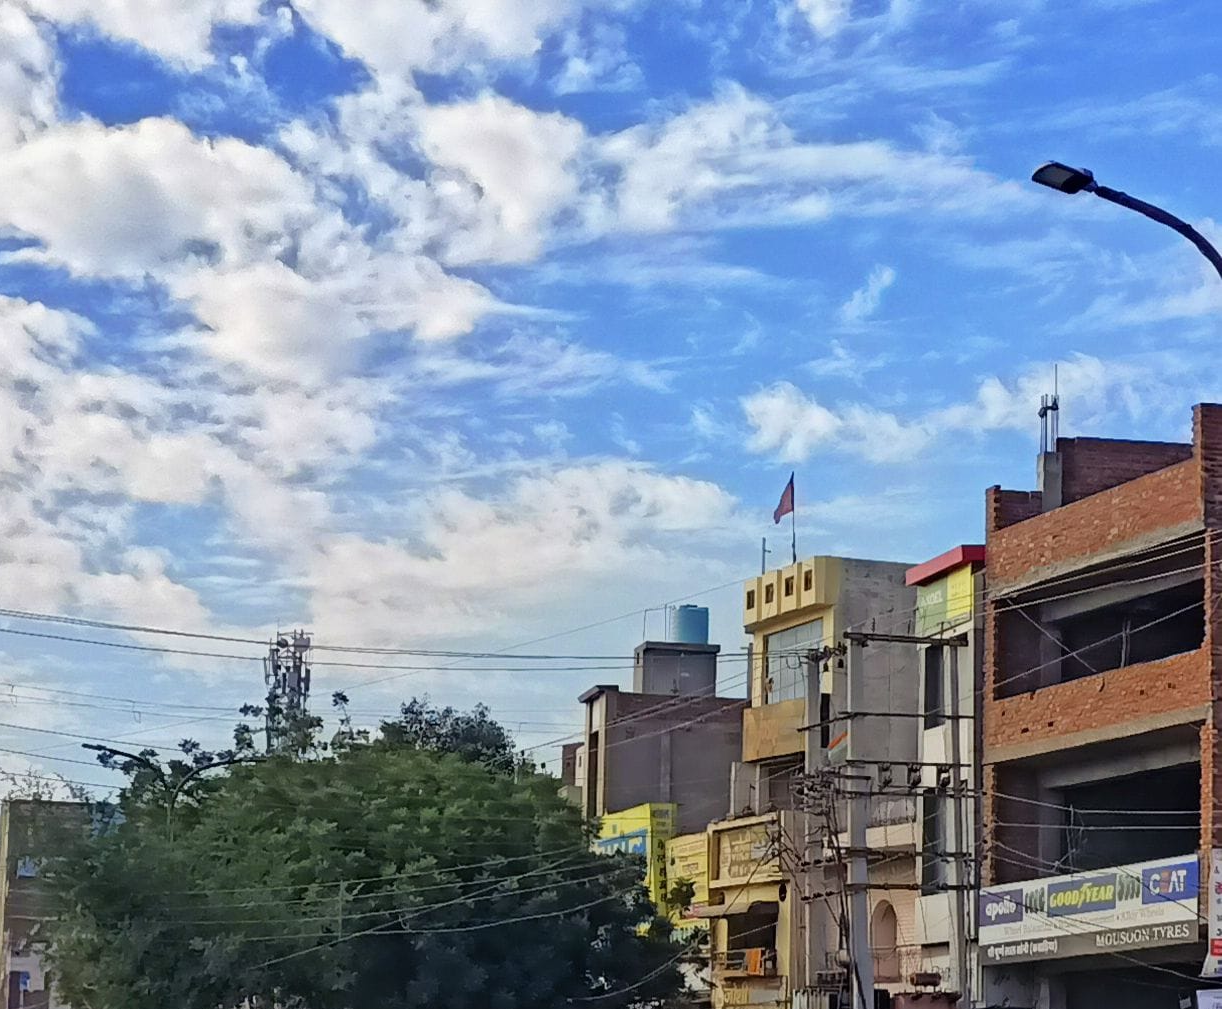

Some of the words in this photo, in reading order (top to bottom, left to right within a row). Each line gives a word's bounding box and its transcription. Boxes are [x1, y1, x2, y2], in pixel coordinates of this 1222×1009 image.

[1049, 882, 1115, 909] GOODYEAR
[1149, 868, 1187, 896] CEAT
[1152, 924, 1190, 940] TYRES
